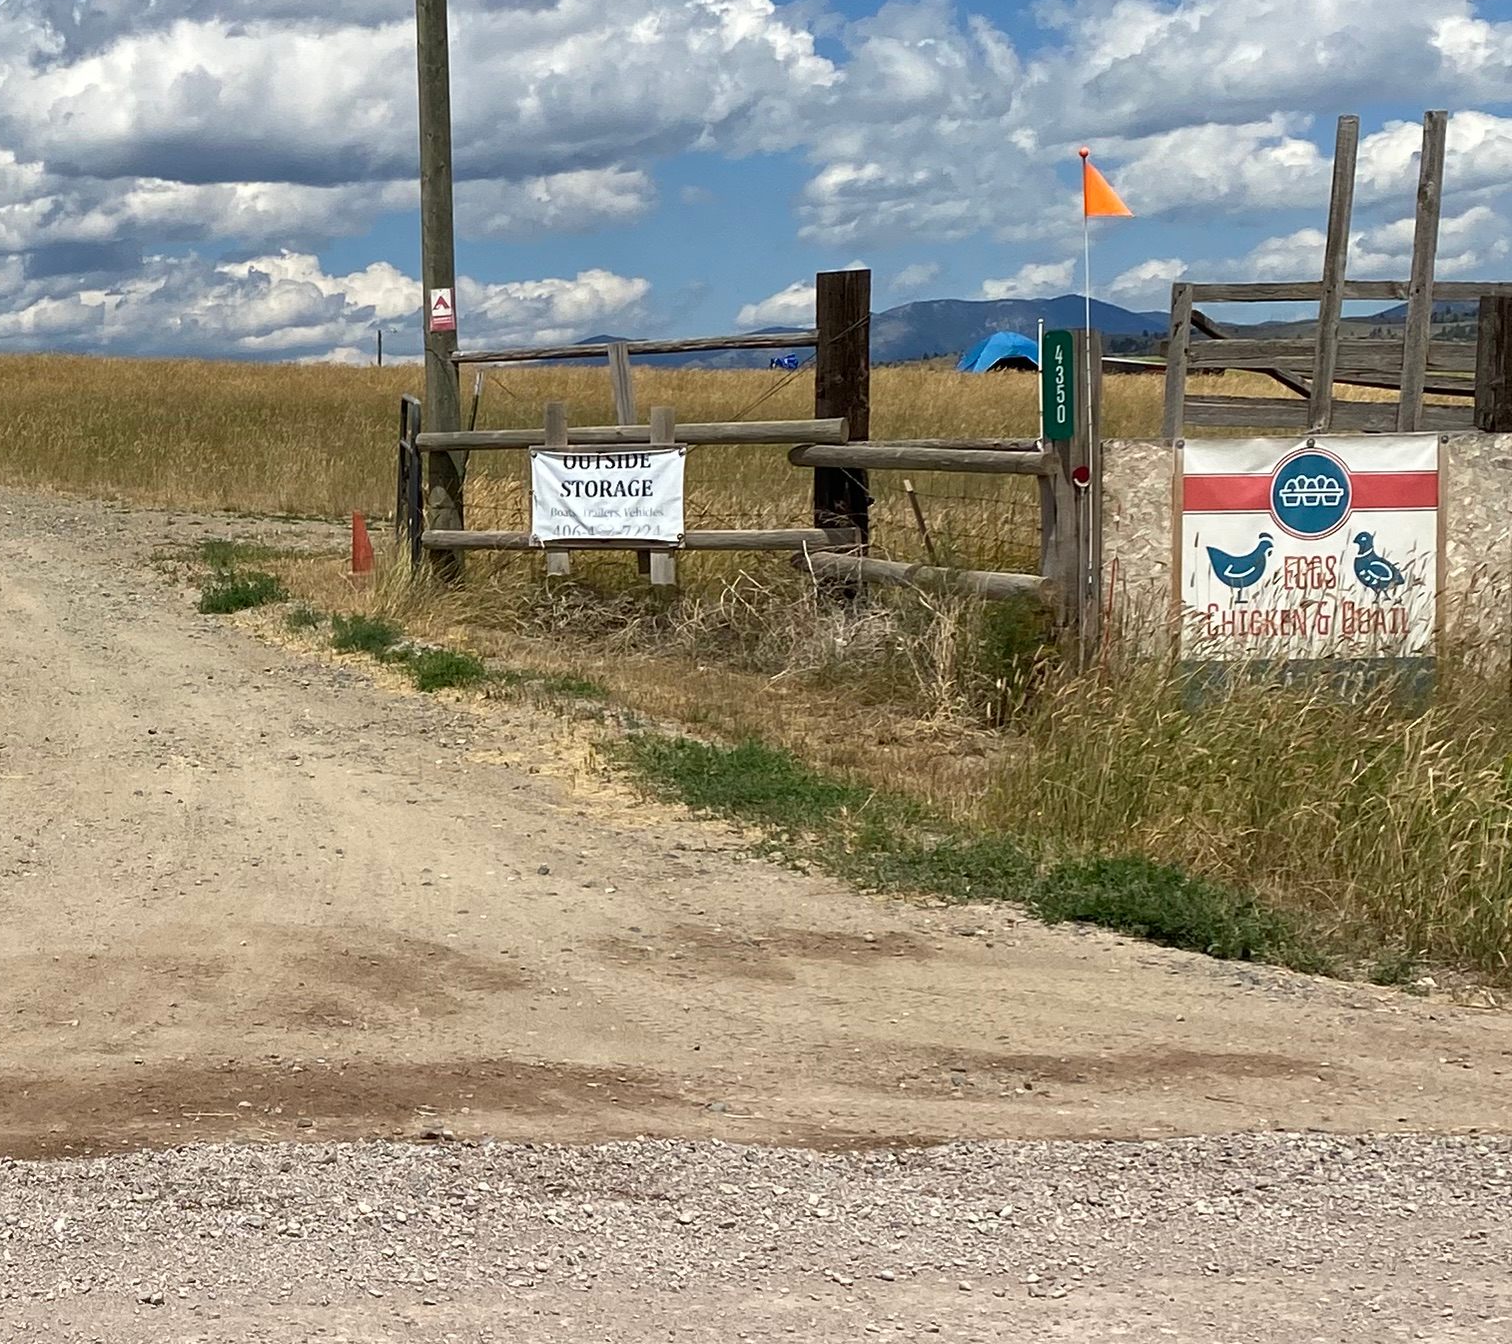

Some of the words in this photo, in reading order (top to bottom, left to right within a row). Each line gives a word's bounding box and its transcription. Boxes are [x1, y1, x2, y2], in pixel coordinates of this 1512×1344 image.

[1055, 344, 1066, 424] 4350
[563, 453, 652, 469] OUTSIDE
[560, 479, 653, 497] STORAGE
[1284, 555, 1337, 590] EGGS
[1315, 601, 1331, 635] &
